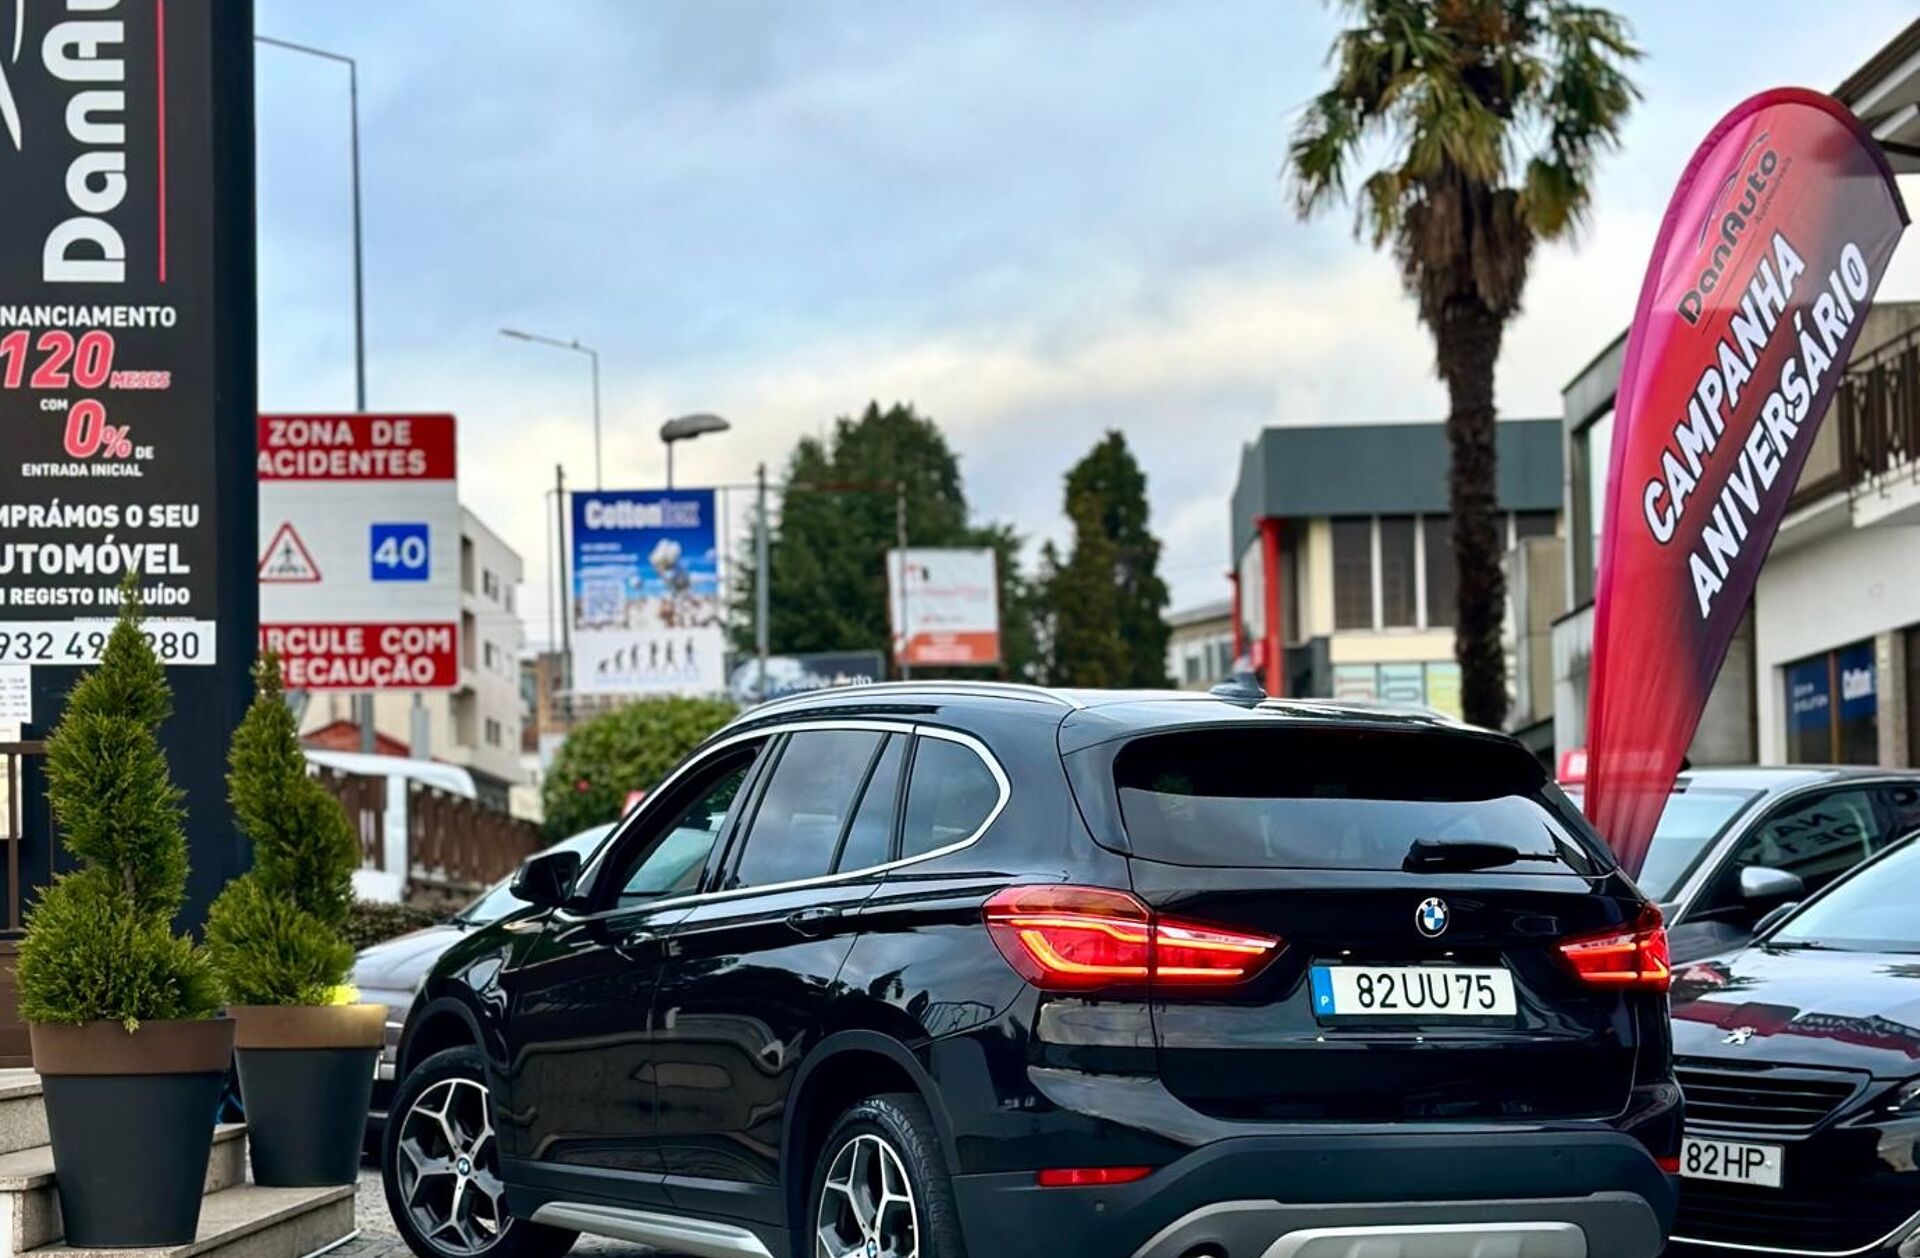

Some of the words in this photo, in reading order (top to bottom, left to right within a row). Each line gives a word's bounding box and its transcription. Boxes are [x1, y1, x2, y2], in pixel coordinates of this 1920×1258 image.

[42, 0, 127, 282] DanA
[1677, 149, 1778, 326] DanAuto
[0, 330, 115, 388] 120
[109, 371, 171, 389] MESES
[1643, 231, 1808, 543] CAMPANHA
[40, 399, 68, 411] COM
[64, 399, 132, 459] 0%
[135, 446, 154, 459] DE
[268, 420, 354, 447] ZONA
[371, 421, 412, 447] DE
[1688, 241, 1870, 618] ANIVERSÁRIO
[22, 463, 88, 477] ENTRADA
[91, 463, 143, 477] INICIAL
[125, 504, 143, 528] O
[149, 504, 199, 528] SEU
[374, 535, 426, 569] 40
[10, 587, 94, 605] REGISTO
[380, 627, 450, 654] COM
[1320, 996, 1329, 1006] P
[1687, 1142, 1765, 1178] 82HP
